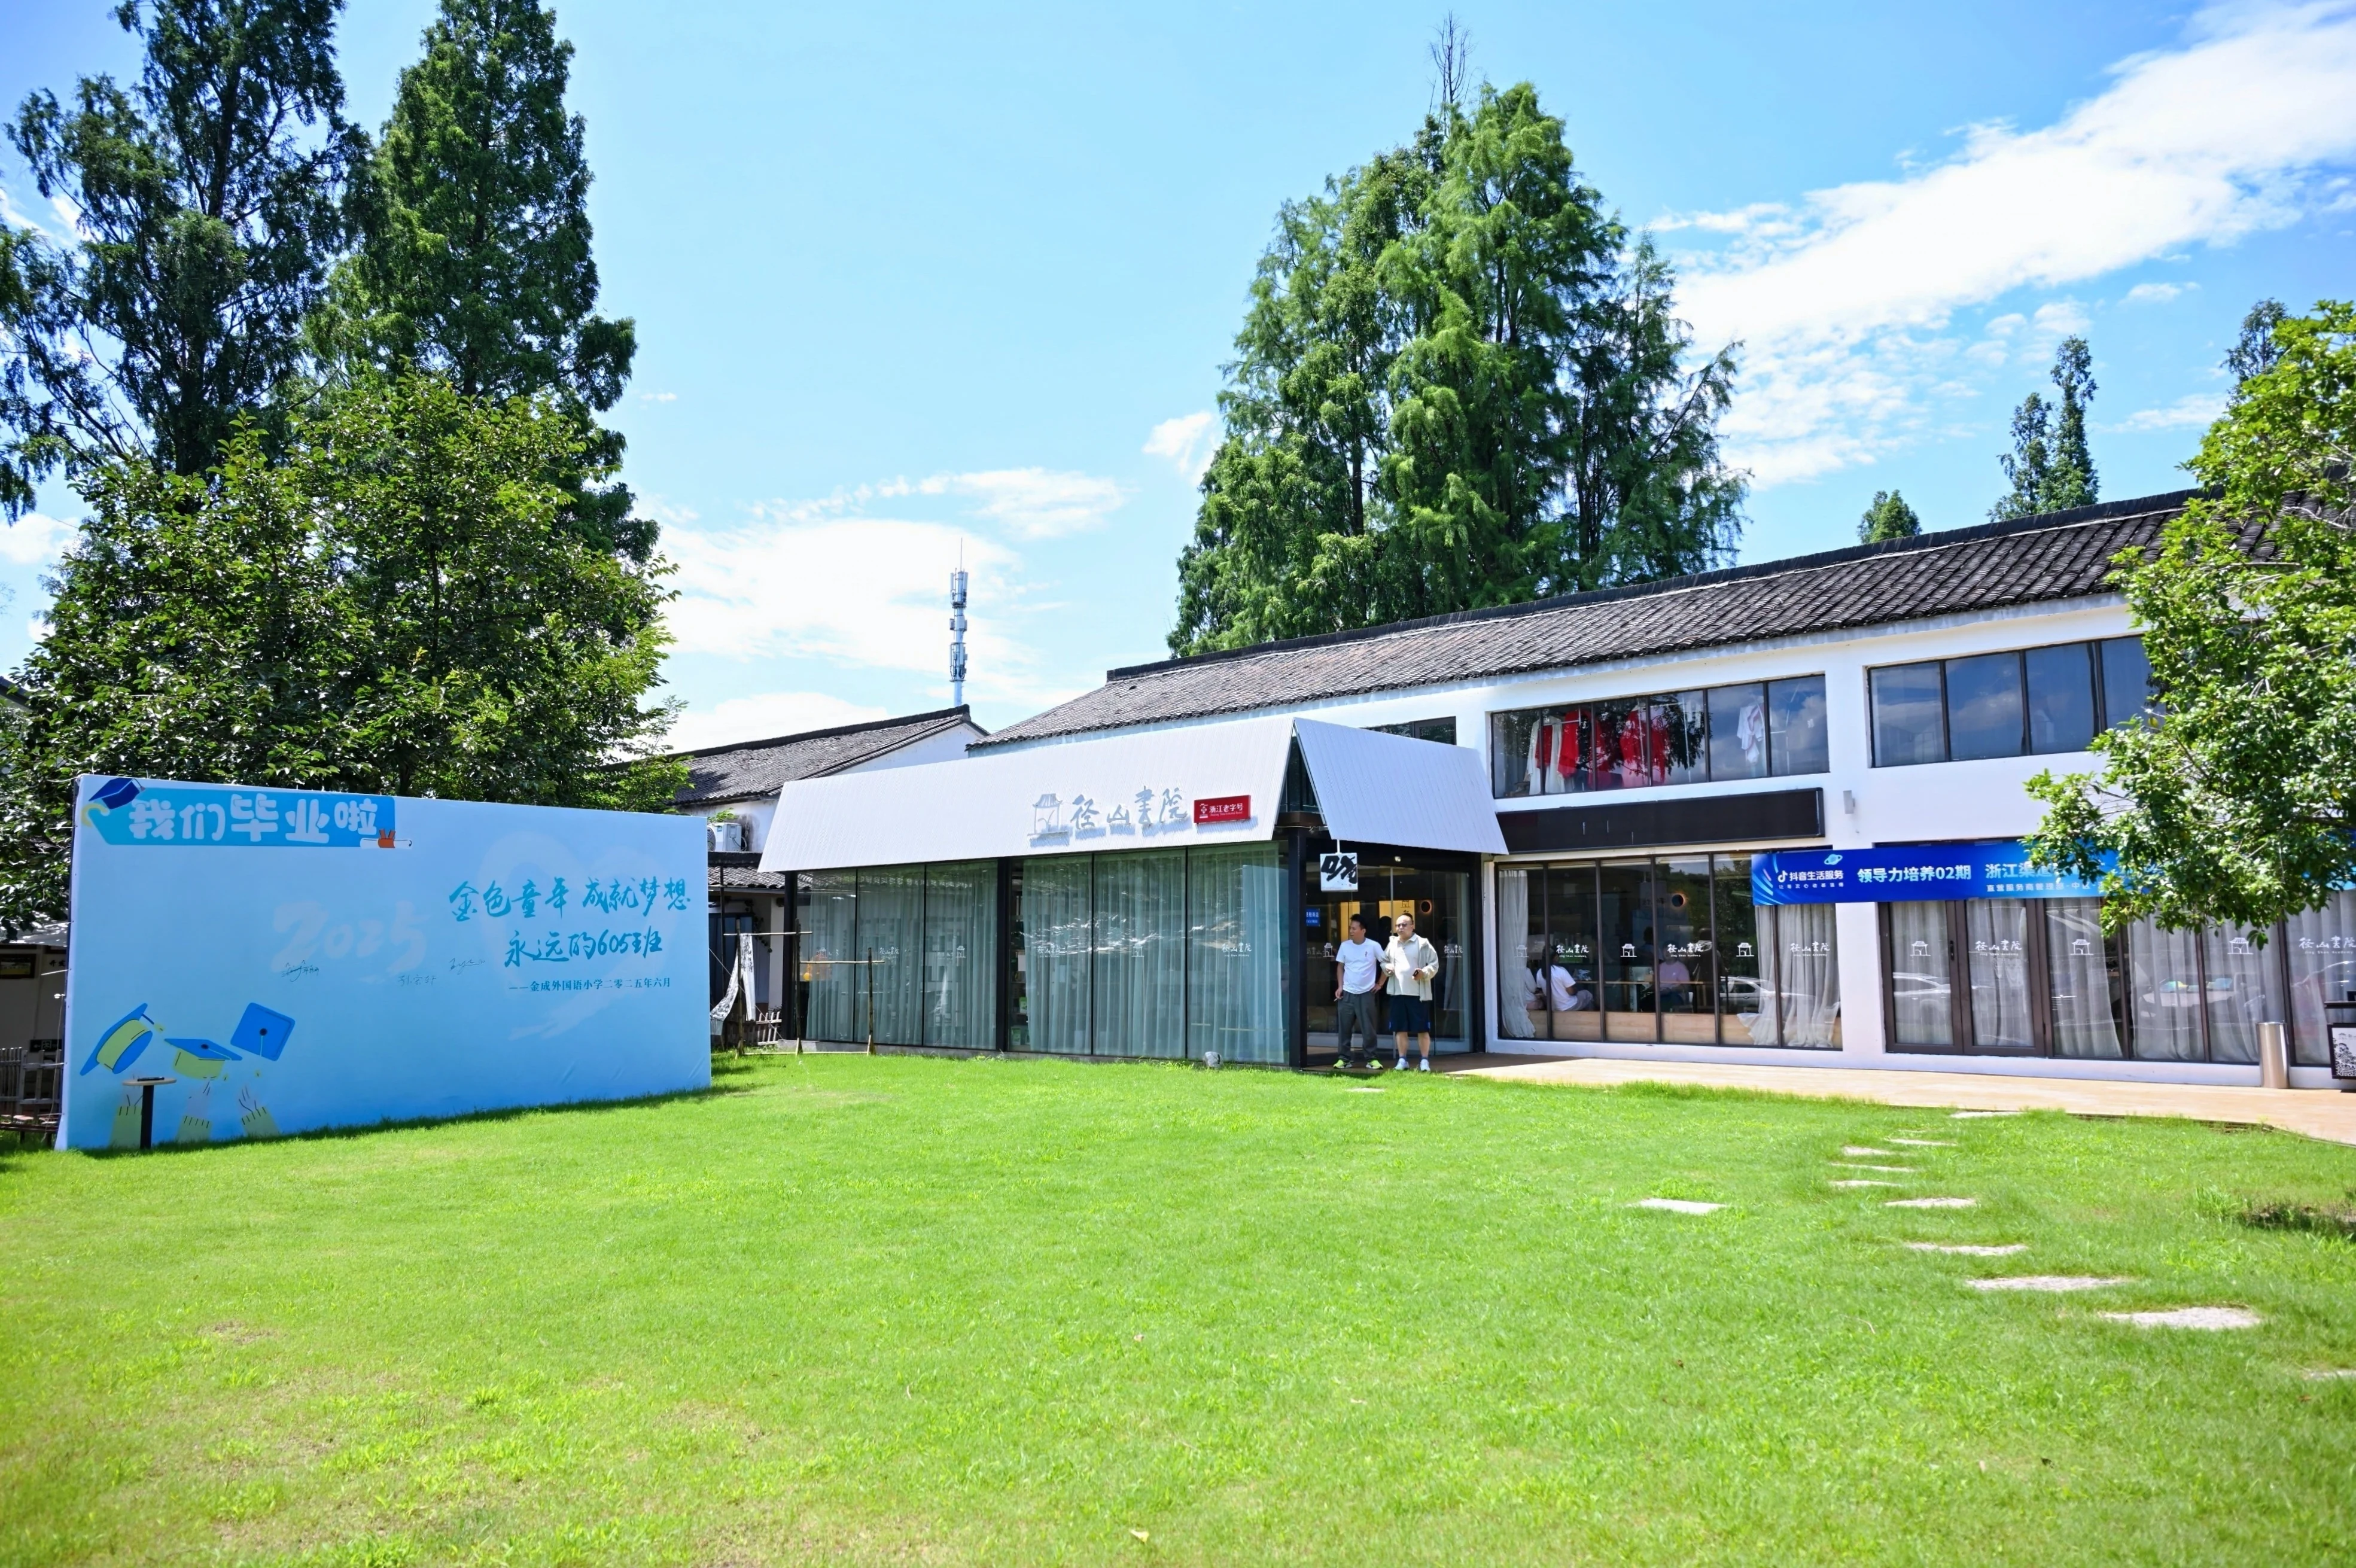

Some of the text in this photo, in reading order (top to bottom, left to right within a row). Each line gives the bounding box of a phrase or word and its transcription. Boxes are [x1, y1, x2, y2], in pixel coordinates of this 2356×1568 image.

[128, 793, 378, 844] 我们毕业啦
[1209, 803, 1243, 814] 浙江老字号
[1789, 869, 1844, 882] 抖音生活服务
[1856, 864, 1972, 884] 领导力培养02期
[449, 875, 691, 922] 金色童年 成就梦想
[504, 925, 663, 968] 永远的605班
